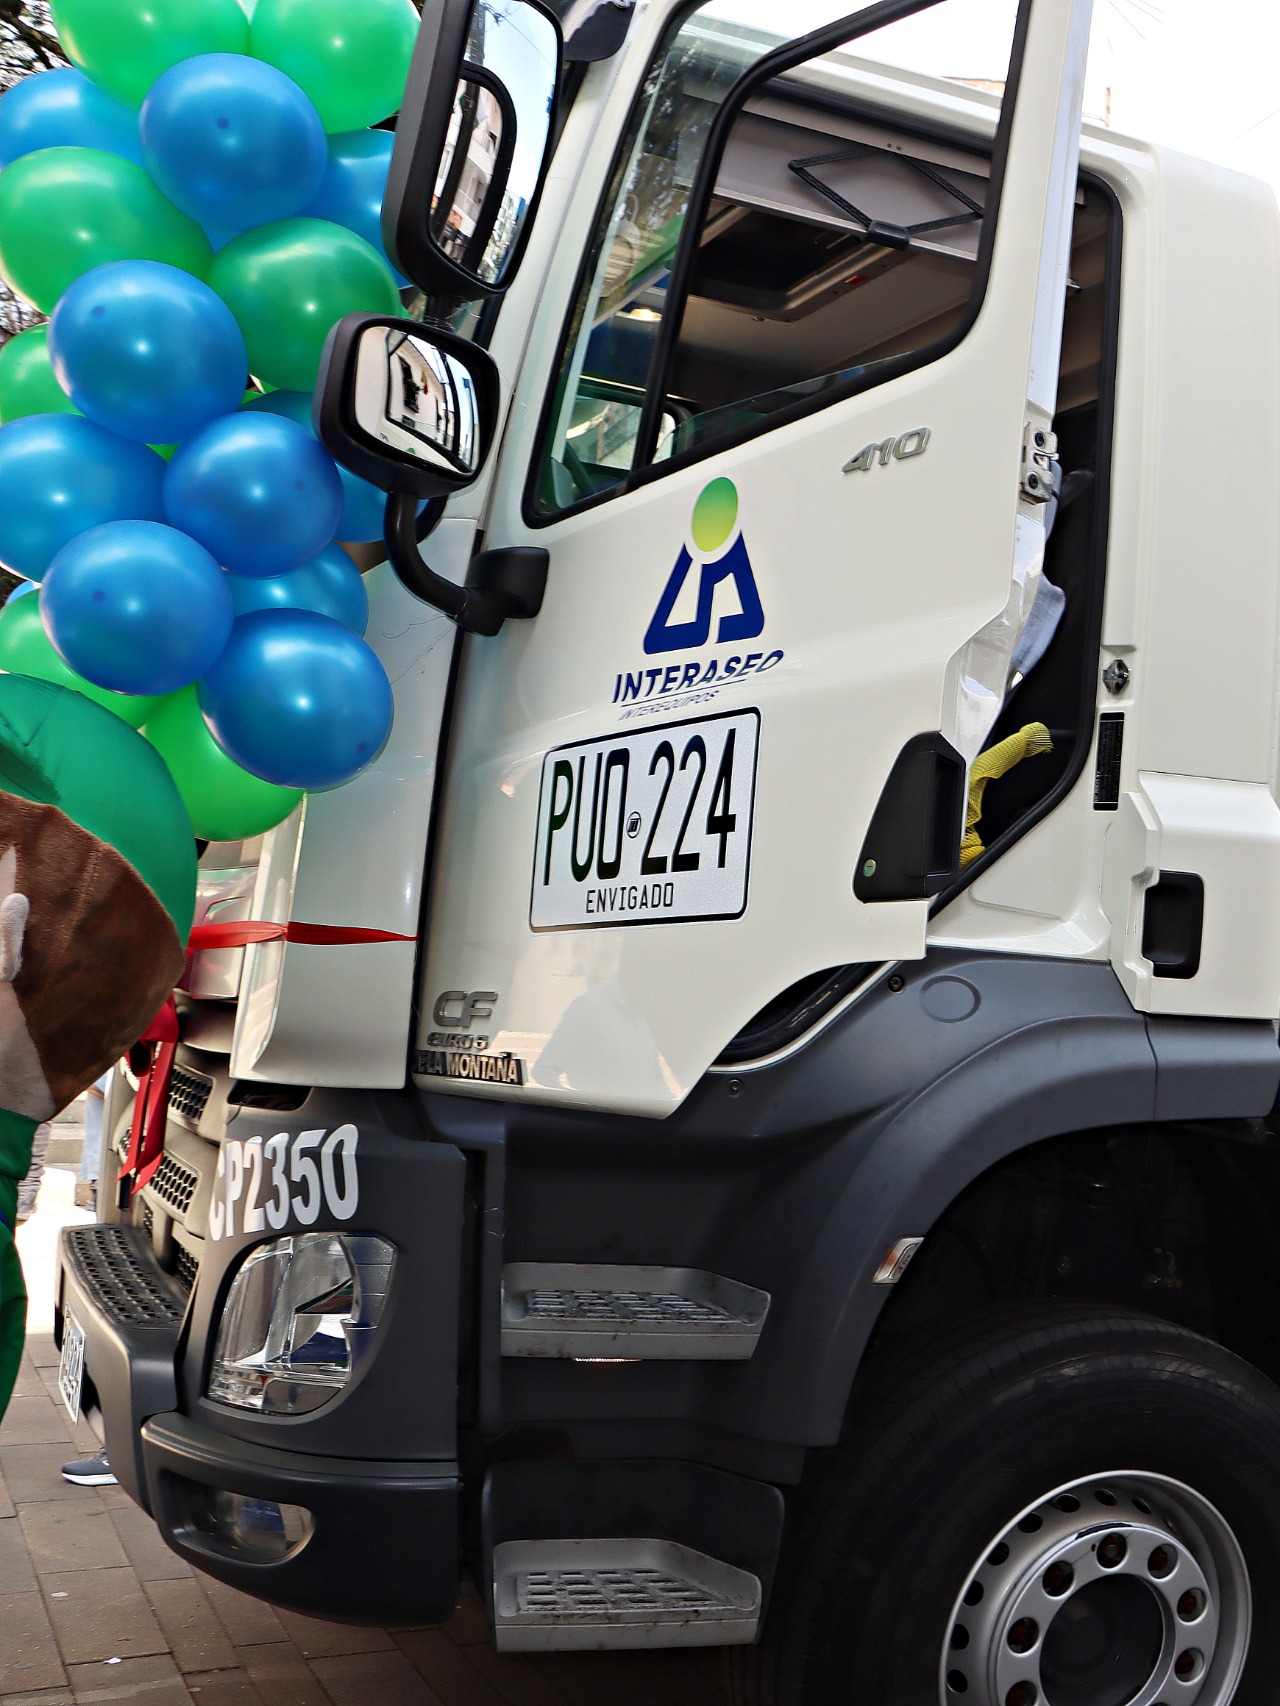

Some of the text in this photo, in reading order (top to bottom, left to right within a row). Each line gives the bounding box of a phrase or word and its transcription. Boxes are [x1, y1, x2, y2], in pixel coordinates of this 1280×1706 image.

[841, 427, 931, 473] 410
[612, 650, 784, 703] INTERASEO
[586, 882, 674, 913] ENVIGADO
[432, 990, 499, 1028] CF
[209, 1123, 360, 1242] CP2350
